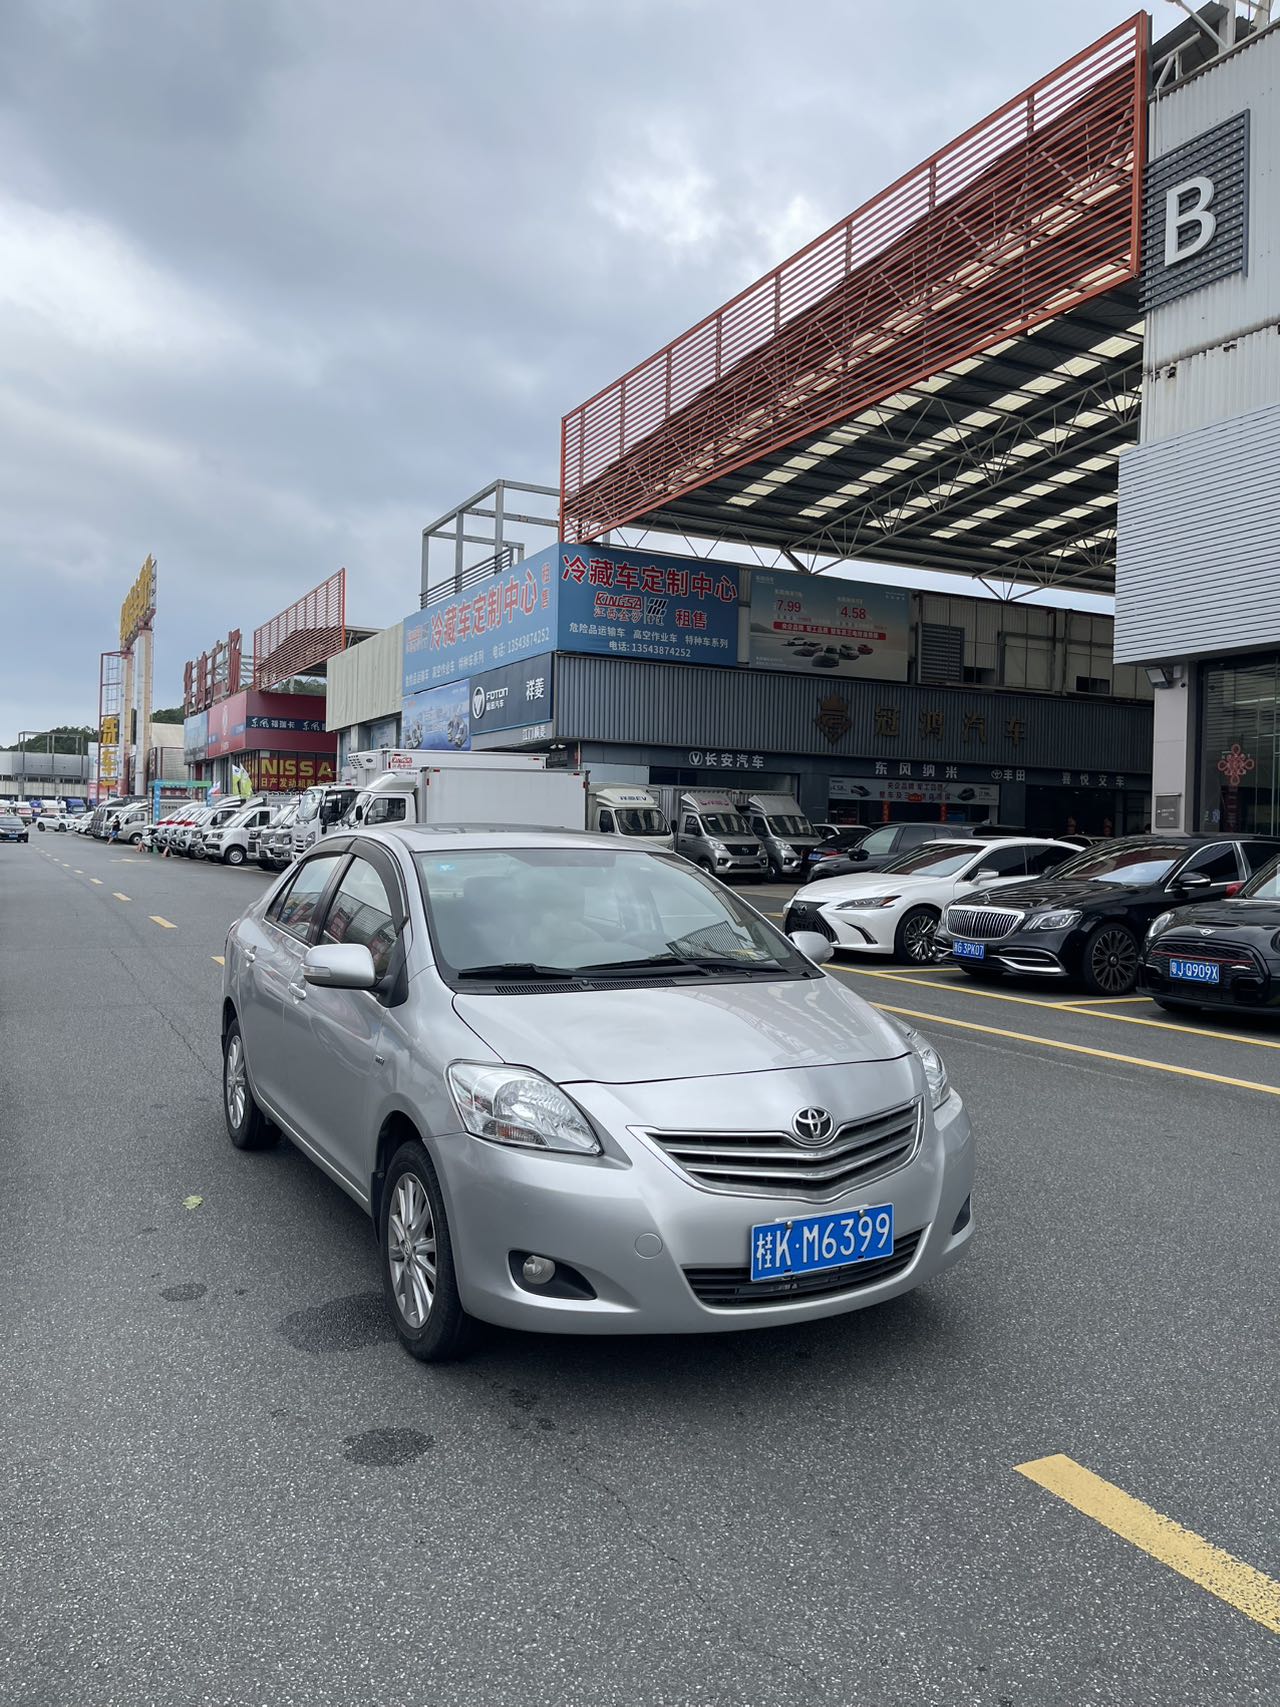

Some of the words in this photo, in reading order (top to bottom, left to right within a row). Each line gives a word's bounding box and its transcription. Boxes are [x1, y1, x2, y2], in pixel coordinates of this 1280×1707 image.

[1164, 176, 1216, 267] B
[562, 554, 738, 603] 冷藏车定制中心
[431, 569, 538, 650] 冷藏车定制中心
[595, 592, 643, 610] KINGSA
[777, 599, 801, 613] 7.99
[840, 606, 866, 620] 4.58
[594, 607, 643, 623] 江西金沙
[675, 609, 708, 630] 租售
[570, 622, 626, 638] 危险品运输车
[633, 629, 678, 644] 高空作业车
[686, 635, 729, 649] 特种车系列
[631, 644, 692, 658] 13543874252
[486, 688, 509, 701] FOTON
[526, 677, 545, 701] 祥菱
[705, 752, 765, 769] 长安汽车
[875, 762, 961, 780] 东风纳米
[1002, 769, 1025, 783] 丰田
[757, 1213, 891, 1271] 桂K·M6399
